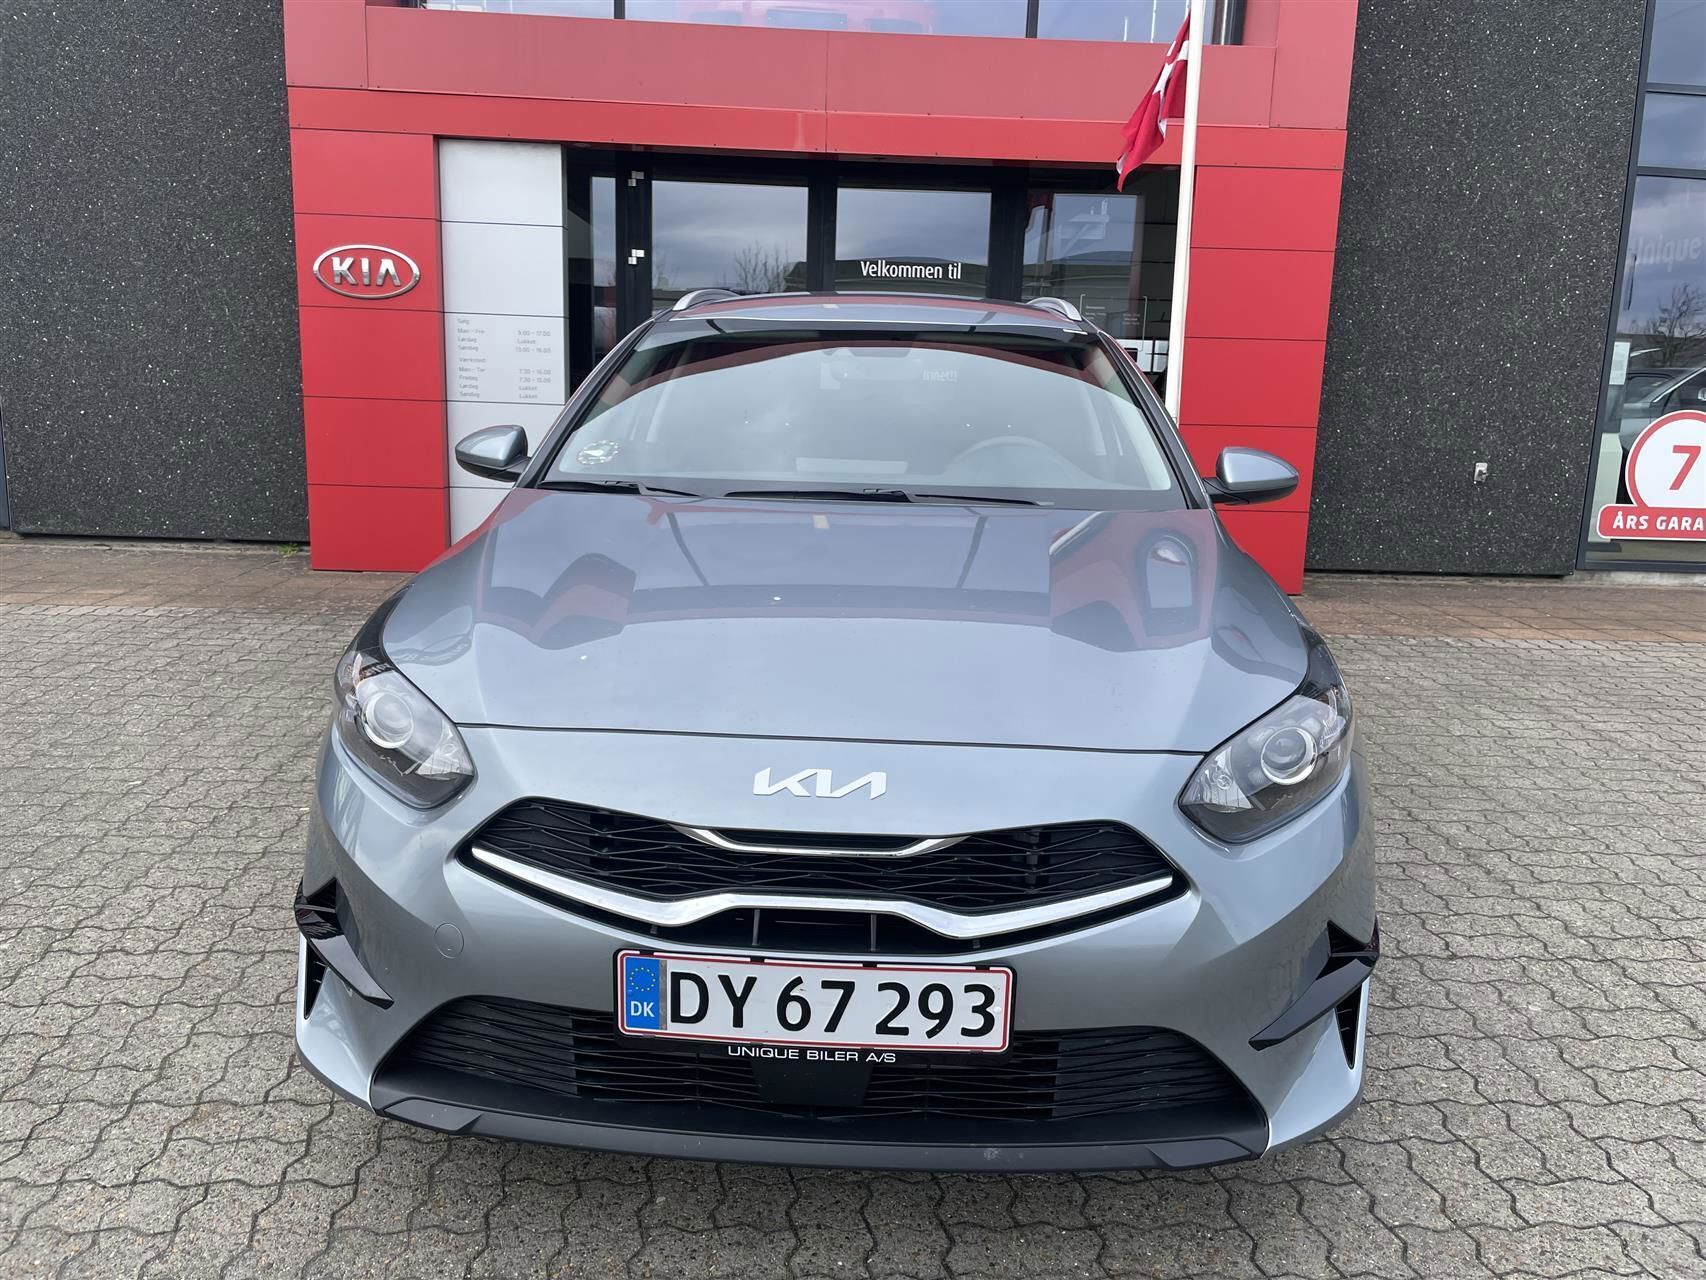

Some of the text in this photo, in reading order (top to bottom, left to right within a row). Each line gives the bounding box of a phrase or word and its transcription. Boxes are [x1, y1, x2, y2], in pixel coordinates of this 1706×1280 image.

[331, 256, 402, 287] KIA
[860, 259, 962, 280] Velkommen til
[1669, 445, 1702, 491] 7
[1612, 510, 1704, 531] ÅRS GARA
[753, 767, 887, 800] KIA
[630, 1000, 655, 1018] DK
[669, 971, 997, 1038] DY 67 293
[728, 1045, 896, 1064] UNIQUE BILER A/S
